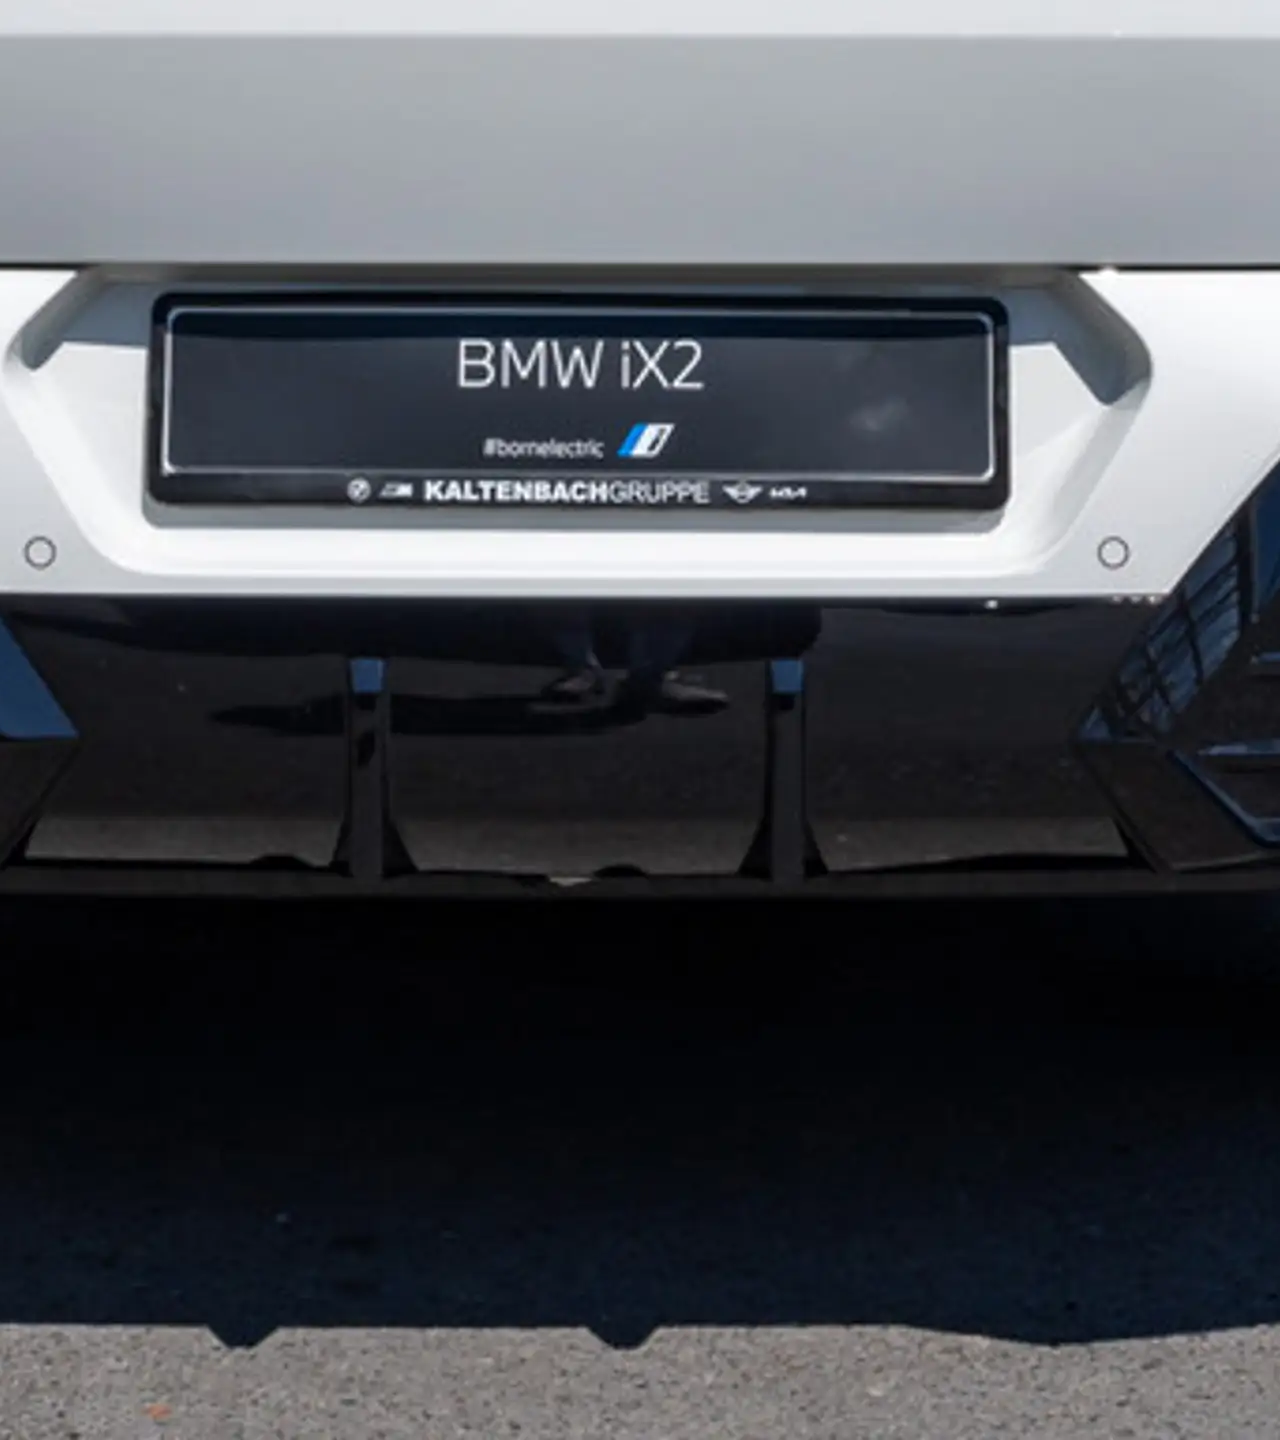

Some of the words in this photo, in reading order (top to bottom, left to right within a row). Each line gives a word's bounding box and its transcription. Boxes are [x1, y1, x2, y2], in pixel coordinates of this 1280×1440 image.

[457, 338, 605, 390] BMW
[620, 338, 706, 391] iX2
[424, 479, 711, 504] KALTENBACHGRUPPE
